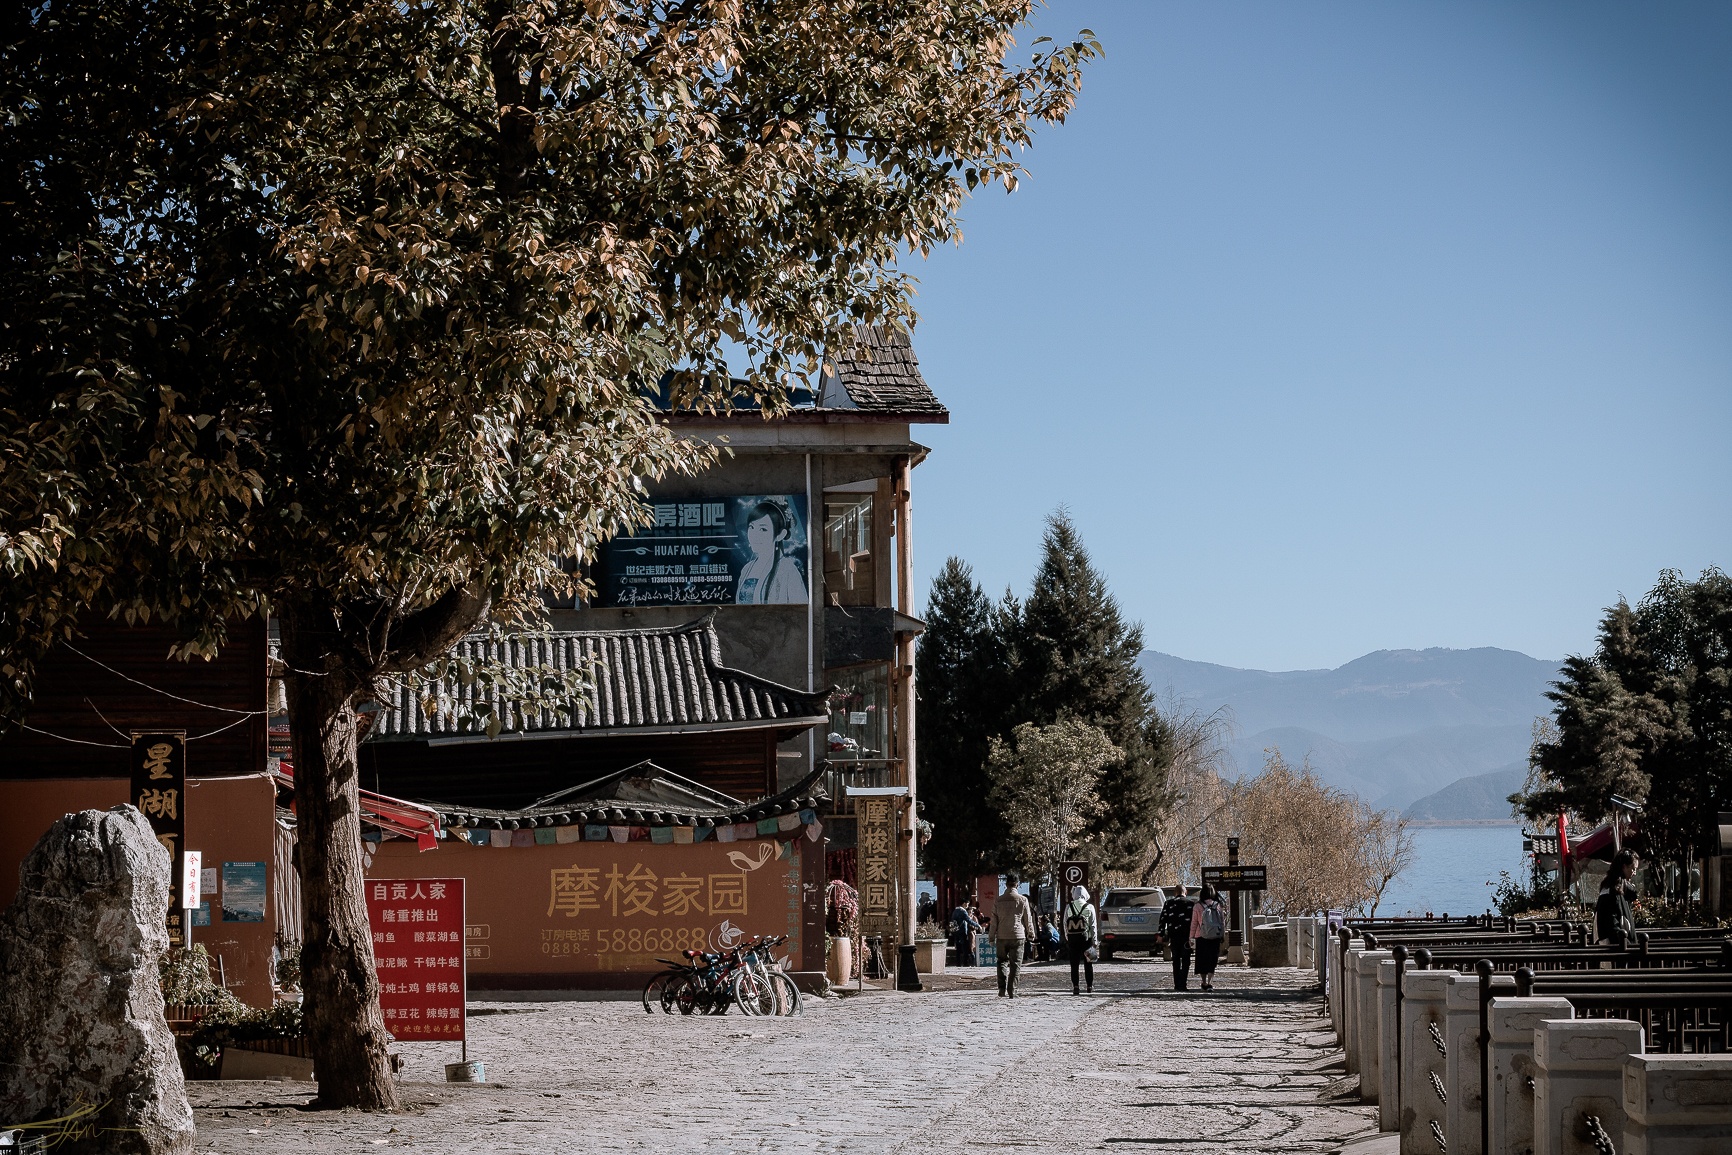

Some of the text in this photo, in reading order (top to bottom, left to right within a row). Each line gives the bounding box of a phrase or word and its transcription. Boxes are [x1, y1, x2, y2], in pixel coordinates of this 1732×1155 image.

[654, 544, 699, 556] HUAFANG
[865, 799, 889, 909] 摩梭家园
[187, 853, 199, 907] 今日有房
[1070, 869, 1080, 881] P
[373, 883, 447, 901] 自贡人家
[546, 863, 748, 917] 摩梭家园
[382, 908, 439, 923] 隆重推出
[414, 931, 460, 943] 酸菜湖鱼
[541, 928, 591, 942] 订房电话
[541, 927, 706, 954] 0888- 5886888
[414, 957, 460, 969] 干锅牛蛙
[425, 982, 460, 994] 鲜锅兔
[425, 1007, 460, 1020] 辣螃蟹
[403, 1023, 461, 1034] 欢迎您的光临
